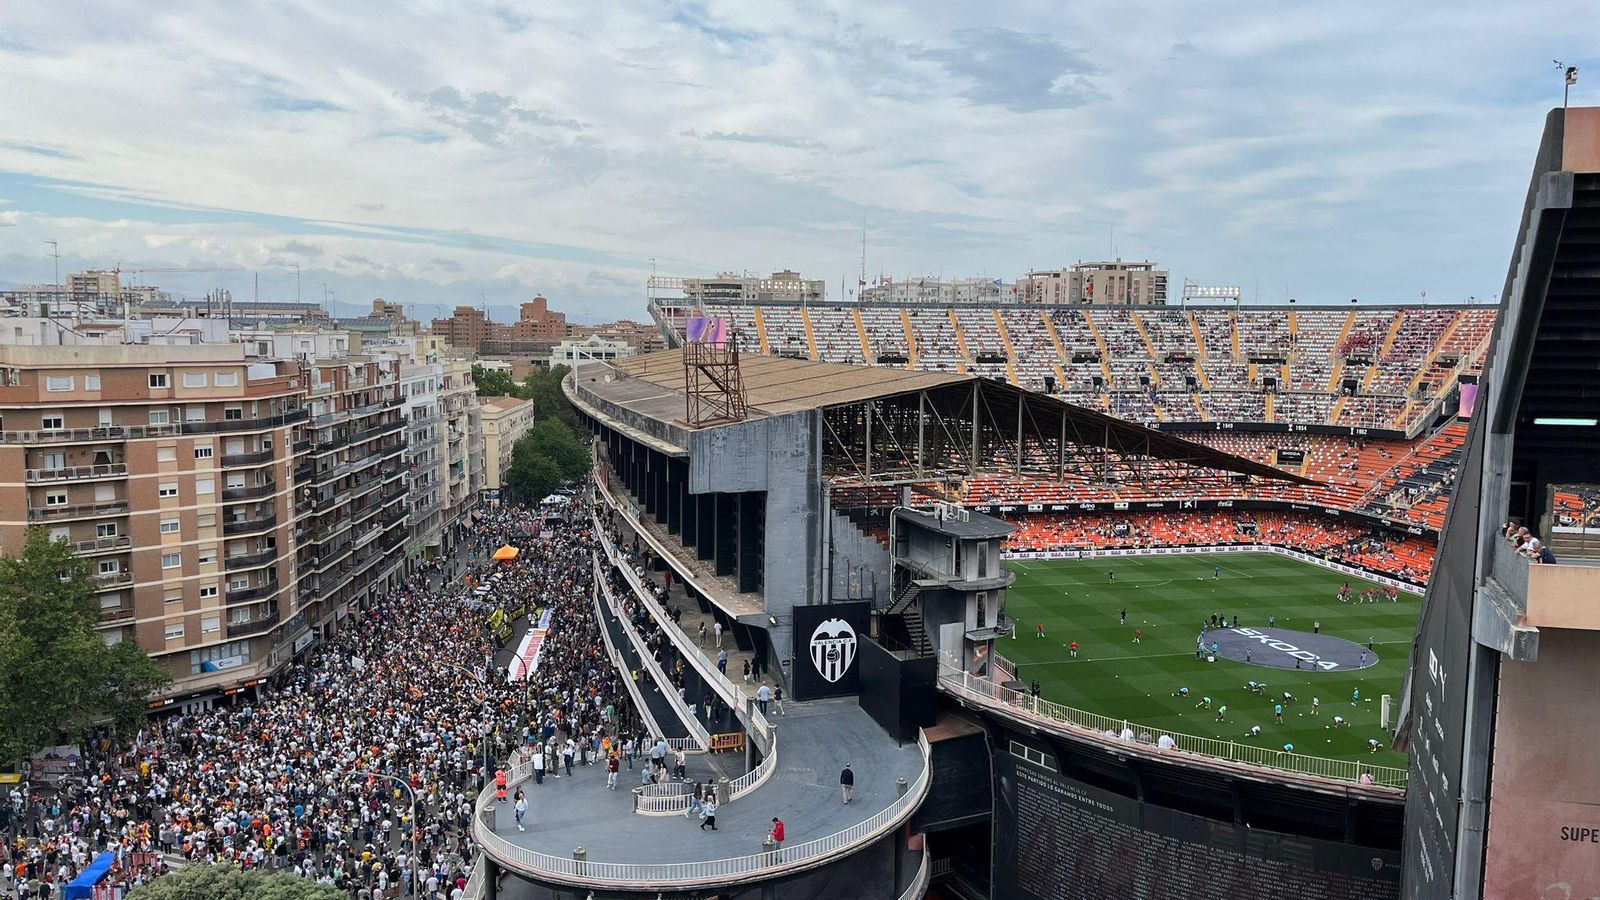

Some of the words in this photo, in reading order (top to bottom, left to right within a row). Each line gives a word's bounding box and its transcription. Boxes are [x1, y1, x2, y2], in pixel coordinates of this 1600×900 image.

[1230, 627, 1340, 671] SKODA
[1016, 764, 1037, 777] EMPRESAS
[1016, 770, 1027, 779] ESTE
[1028, 775, 1046, 787] PARTIDO
[1054, 786, 1078, 800] GANAMOS
[1078, 795, 1096, 806] ENTRE
[1096, 801, 1114, 812] TODOS
[1561, 826, 1600, 843] SUPE
